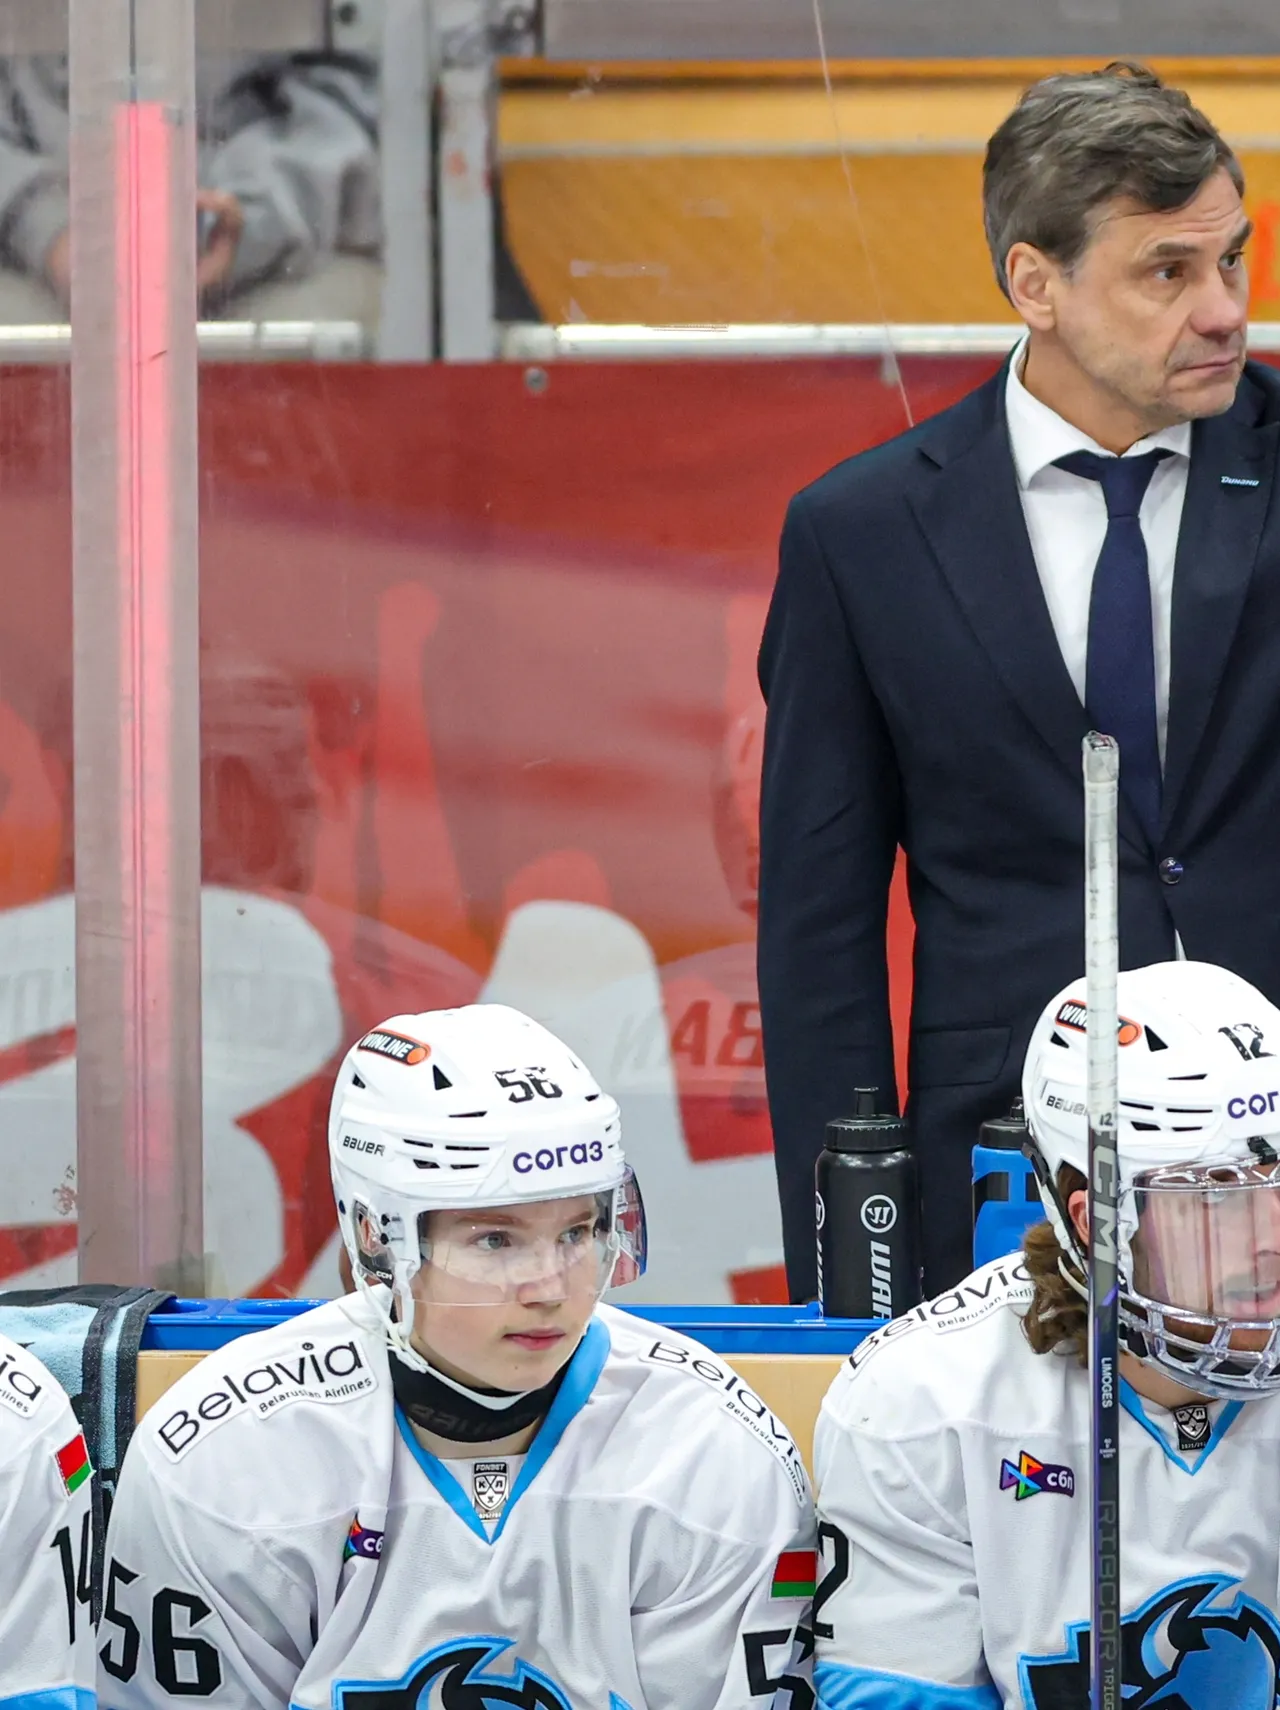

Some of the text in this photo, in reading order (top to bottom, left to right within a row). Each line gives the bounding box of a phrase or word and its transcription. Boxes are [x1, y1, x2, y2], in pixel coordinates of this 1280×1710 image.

[361, 1032, 413, 1059] WINLINE
[1218, 1022, 1277, 1062] 12
[493, 1066, 563, 1104] 56
[1046, 1095, 1089, 1116] BAUE
[343, 1135, 386, 1157] BAUER
[512, 1140, 604, 1174] согаз
[1092, 1129, 1117, 1266] CM
[937, 1296, 1003, 1329] Belarusian
[158, 1341, 364, 1455] Belavia
[258, 1376, 373, 1414] Belarusian Airlines
[1100, 1356, 1113, 1409] LIMOGES
[647, 1341, 806, 1494] Belavia
[725, 1400, 780, 1453] Belarusian
[99, 1556, 222, 1698] 56
